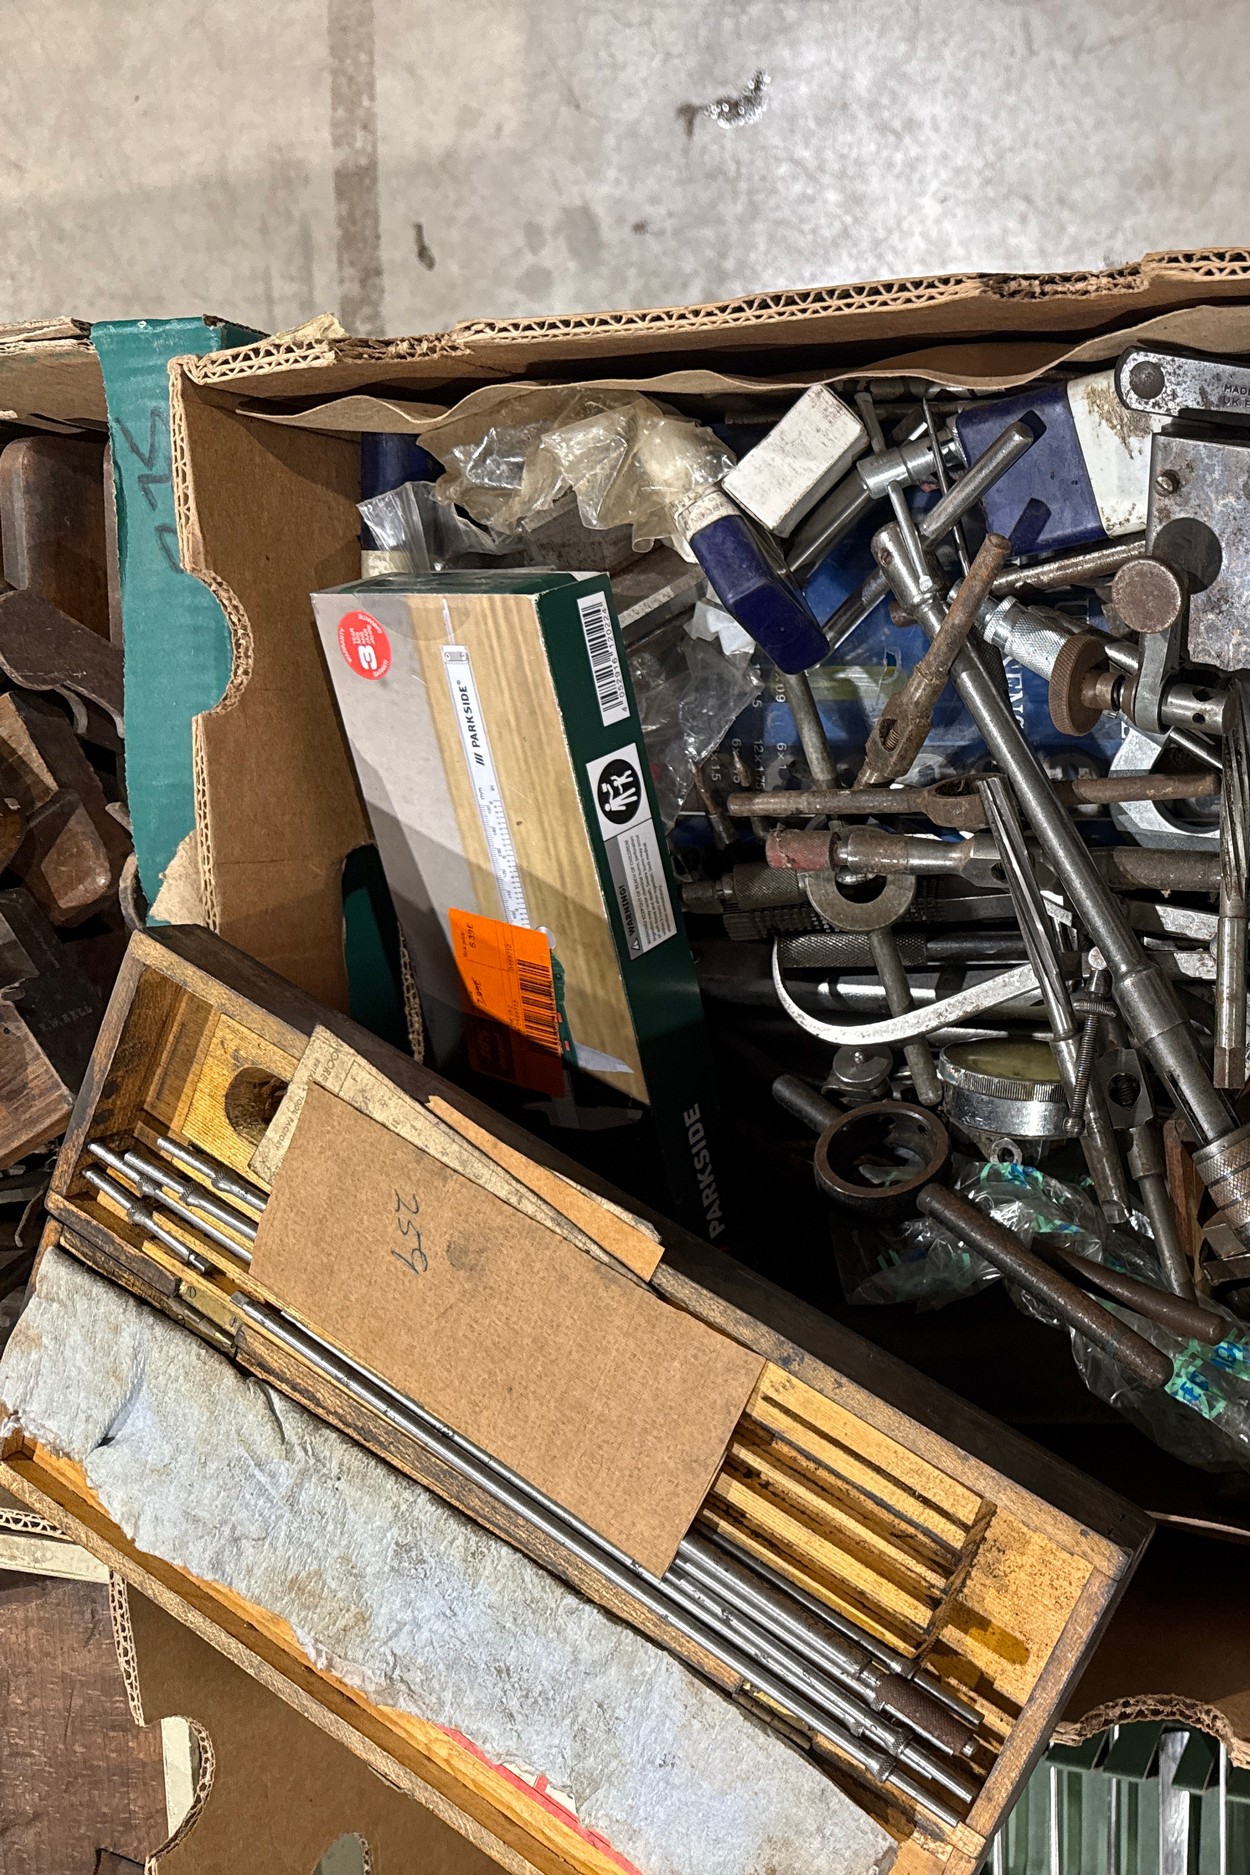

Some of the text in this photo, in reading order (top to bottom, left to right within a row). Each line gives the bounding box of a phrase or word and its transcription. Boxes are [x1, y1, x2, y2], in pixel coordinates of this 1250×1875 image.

[339, 627, 352, 664] WARRANTY
[602, 607, 614, 648] 120224
[358, 645, 378, 670] 3
[612, 657, 625, 698] 052916
[618, 884, 635, 936] WARNING!
[319, 1050, 339, 1083] OORE
[275, 1115, 295, 1152] FACTORY
[683, 1103, 725, 1239] PARKSIDE
